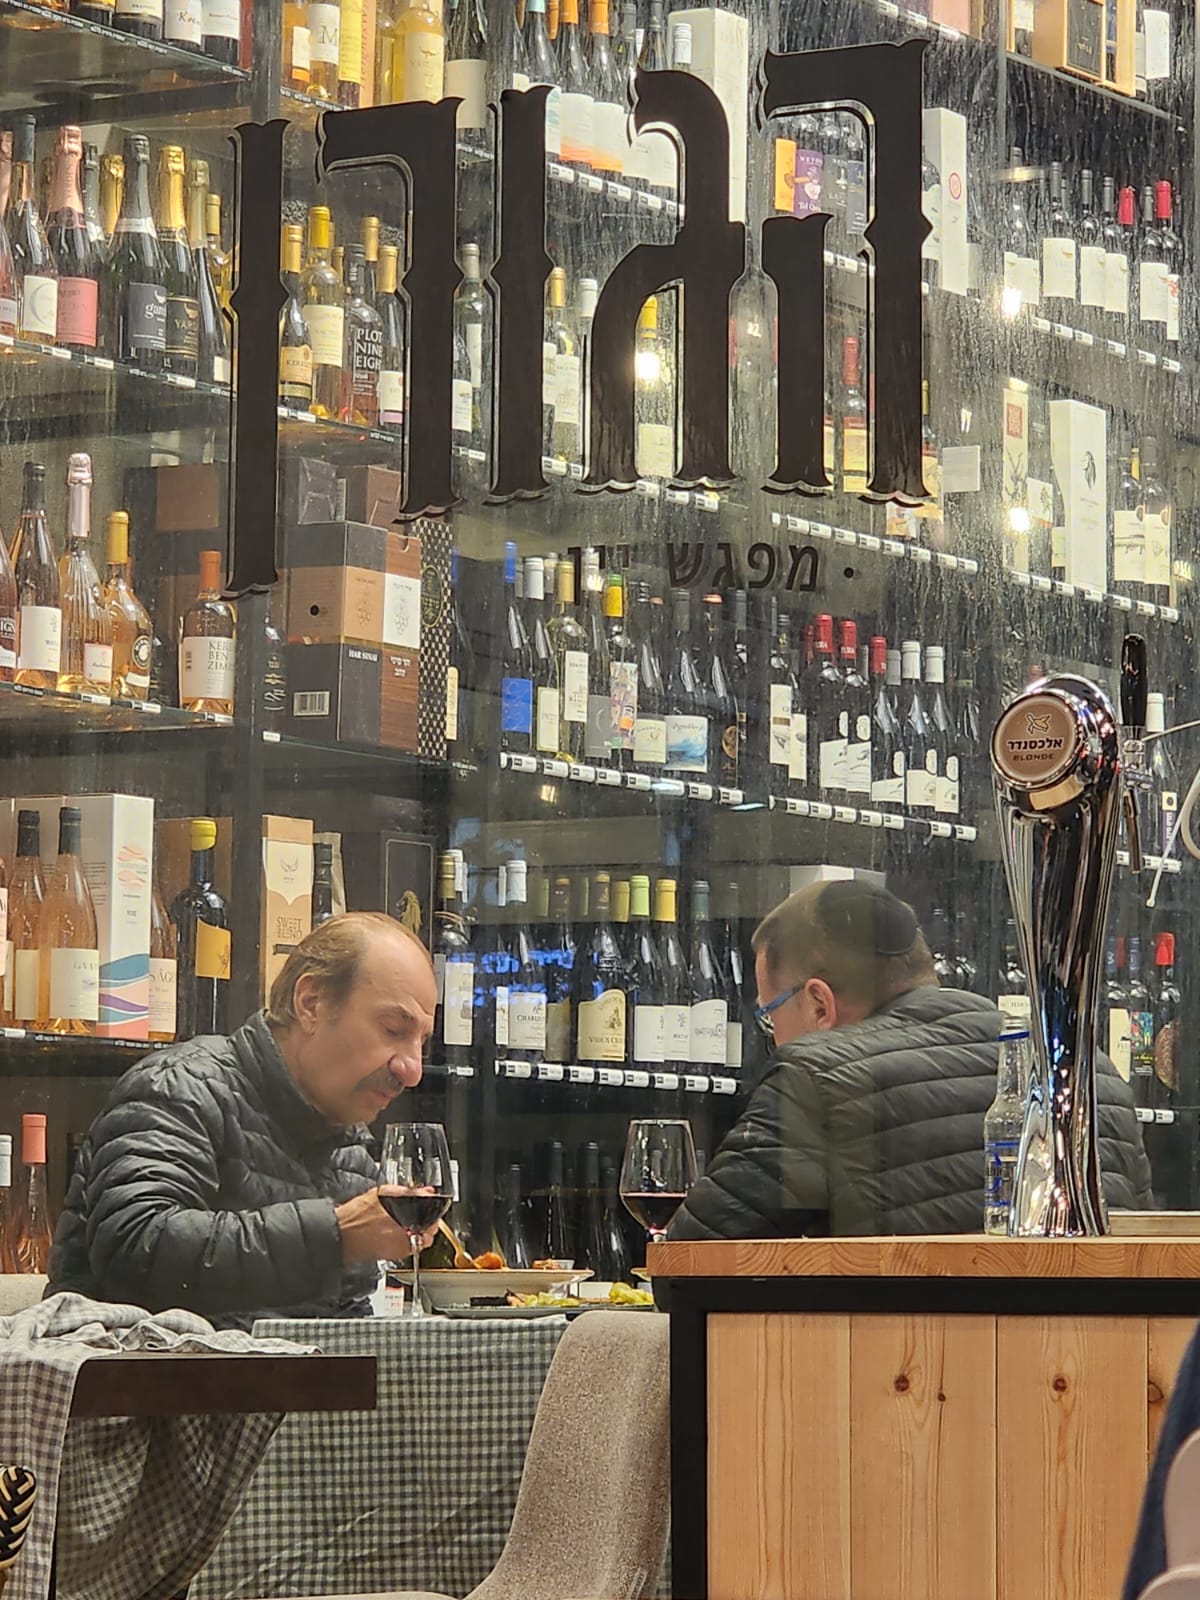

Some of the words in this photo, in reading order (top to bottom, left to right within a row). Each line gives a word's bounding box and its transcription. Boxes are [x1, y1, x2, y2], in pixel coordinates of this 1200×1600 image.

[222, 39, 933, 598] הגורן
[356, 329, 383, 344] PLOT
[355, 342, 383, 358] NINE
[355, 355, 383, 371] EIGH
[666, 541, 820, 593] מפגש
[1007, 737, 1064, 751] אלכסנדר
[1012, 752, 1056, 762] BLONDE
